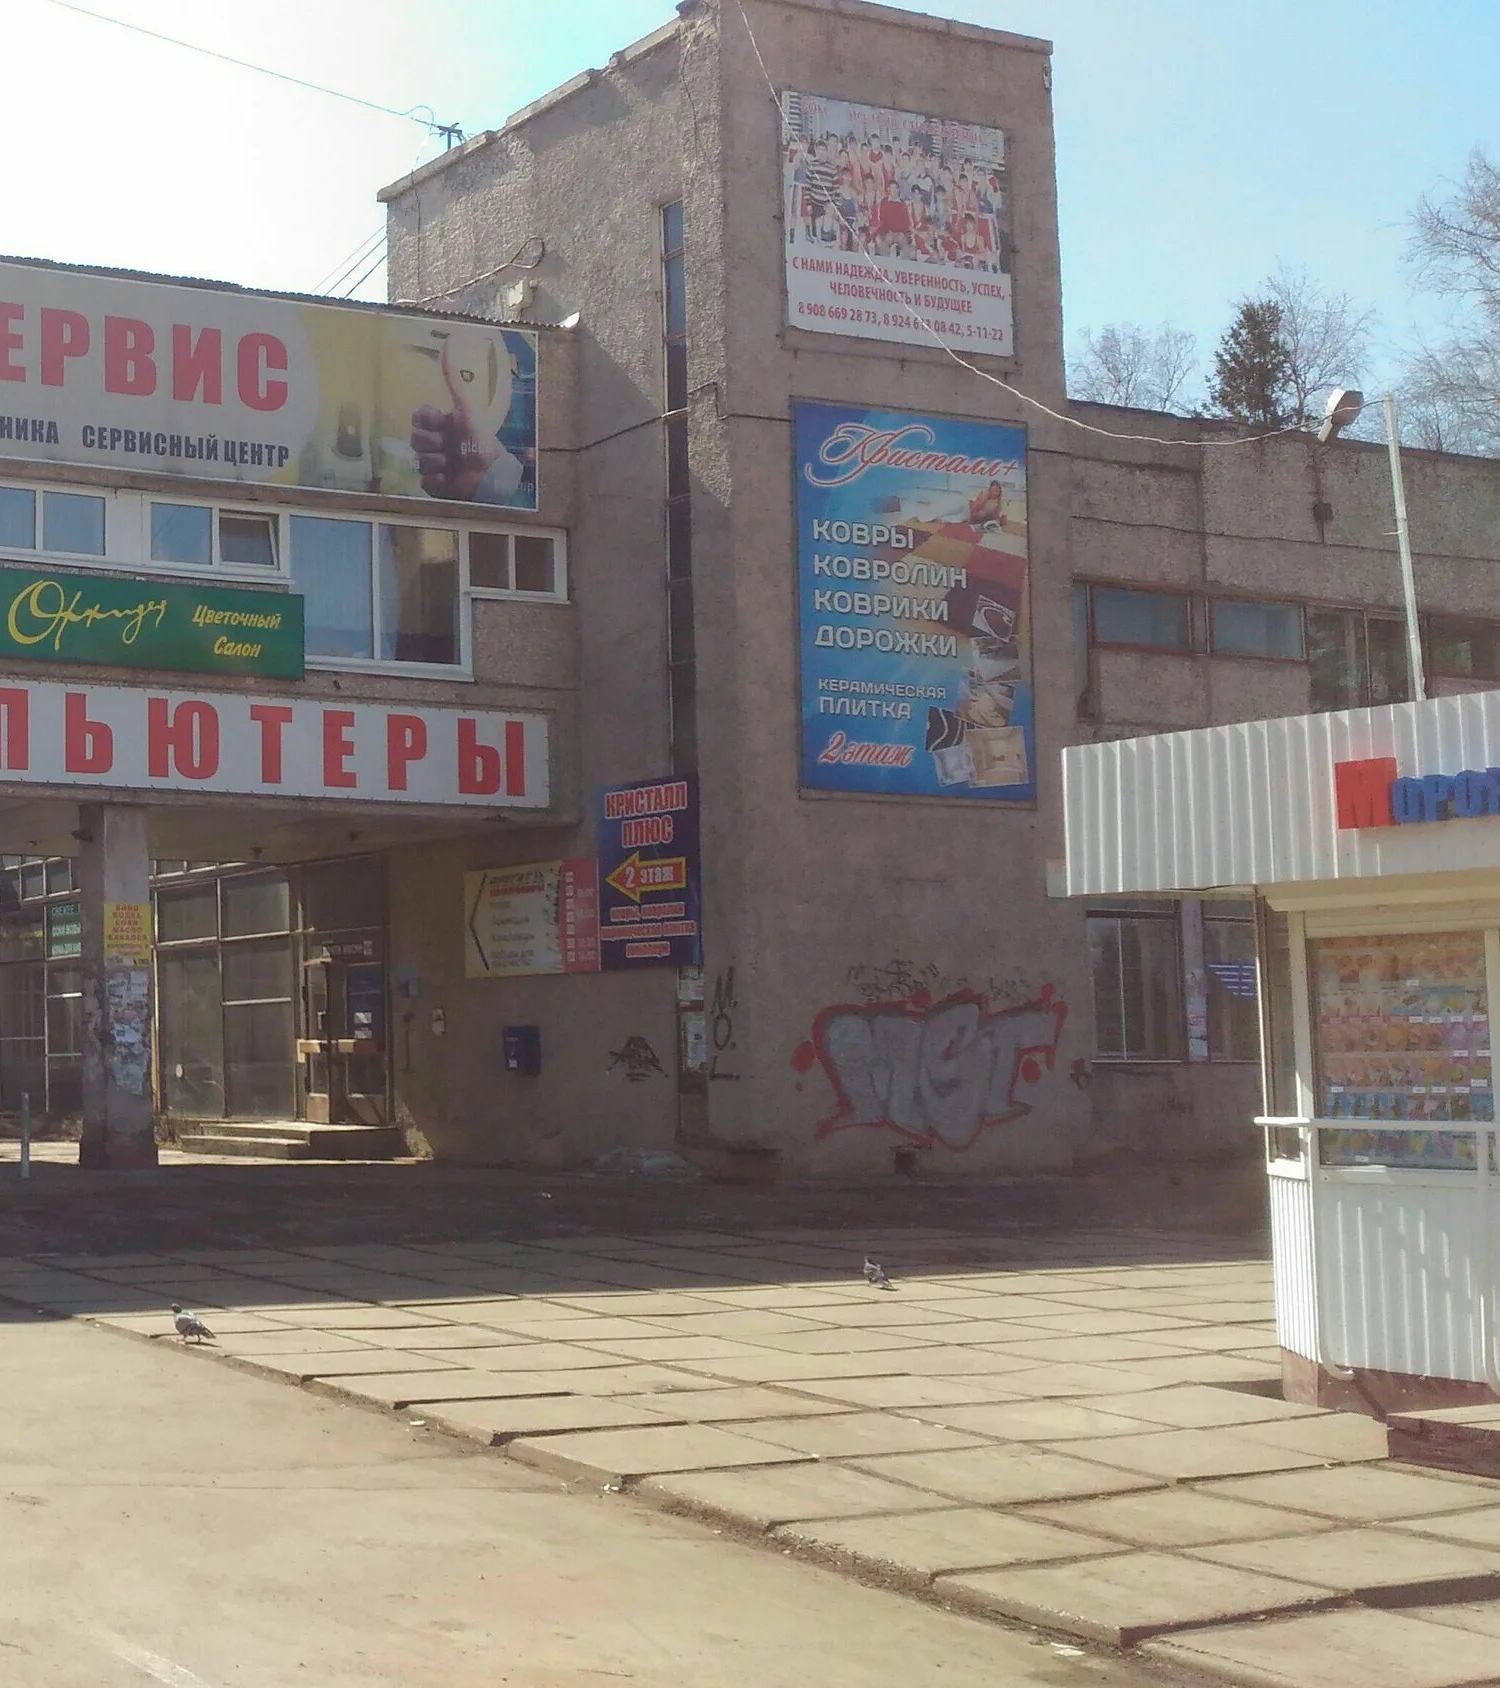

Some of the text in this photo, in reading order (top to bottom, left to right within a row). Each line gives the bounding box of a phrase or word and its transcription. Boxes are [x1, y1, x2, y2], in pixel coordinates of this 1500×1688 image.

[792, 256, 1006, 300] С НАМИ НАДЕЖДА, УВЕРЕННОСТЬ, УСПЕХ,
[830, 282, 972, 314] ЧЕЛОВЕЧНОСТЬ И БУДУЩЕЕ
[798, 301, 804, 314] 8
[806, 303, 826, 317] 908
[828, 306, 847, 319] 669
[850, 308, 863, 322] 28
[883, 314, 890, 325] 8
[891, 315, 911, 329] 924
[933, 320, 946, 333] 08
[967, 324, 1004, 341] 5-11-22
[82, 425, 219, 461] СЕРВИСНЫЙ
[223, 440, 290, 467] ЦЕНТР
[812, 518, 914, 549] КОВРЫ
[813, 554, 968, 589] КОВРОЛИН
[192, 604, 281, 629] Цветочный
[814, 588, 949, 622] КОВРИКИ
[213, 636, 261, 657] Салон
[815, 624, 958, 657] ДОРОЖКИ
[818, 678, 946, 699] КЕРАМИЧЕСКАЯ
[819, 696, 911, 720] ПЛИТКА
[820, 731, 915, 767] 2 этаж
[605, 782, 687, 819] КРИСТАЛЛ
[622, 815, 673, 847] ПЛЮС
[625, 866, 674, 888] 2 этаж
